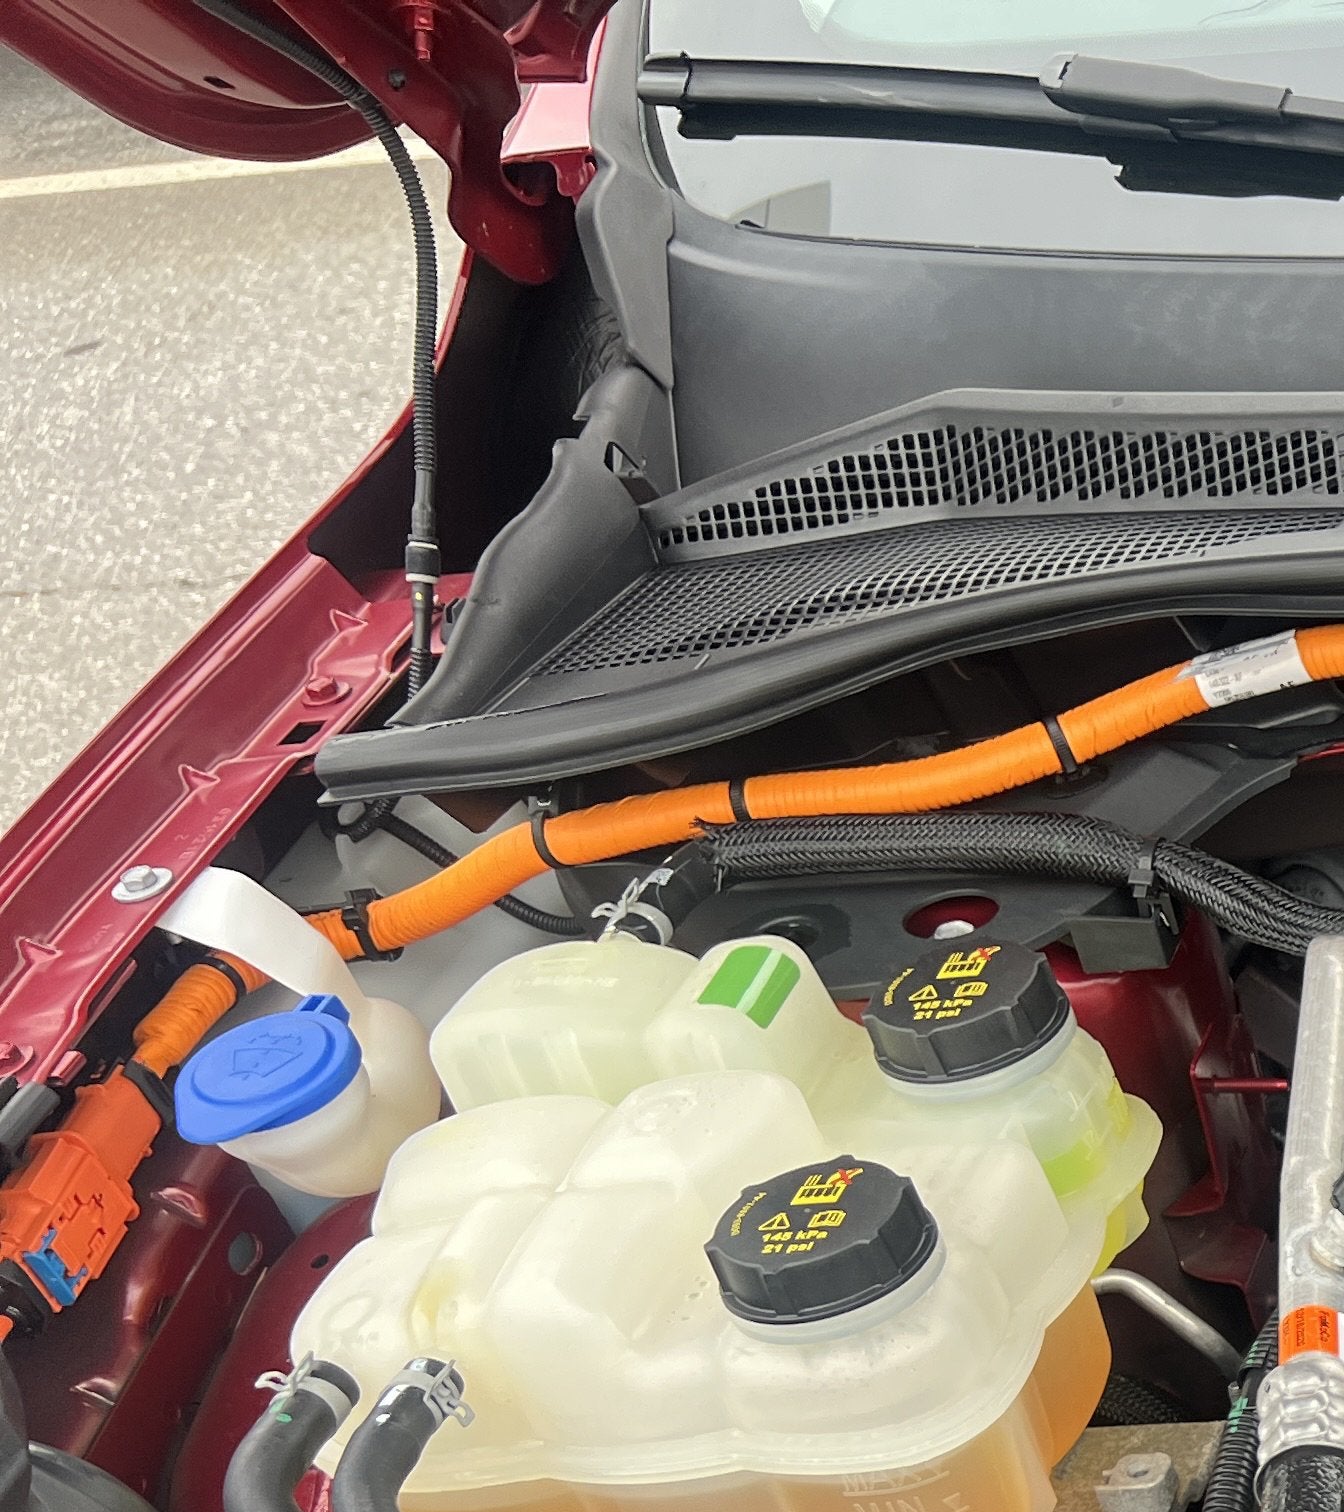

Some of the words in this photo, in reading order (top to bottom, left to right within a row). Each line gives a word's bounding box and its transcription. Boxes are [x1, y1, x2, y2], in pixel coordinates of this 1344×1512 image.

[942, 998, 974, 1009] kPa
[913, 1010, 934, 1021] 21
[935, 1008, 962, 1020] psi
[761, 1231, 793, 1243] 145
[795, 1229, 829, 1241] kPa
[761, 1243, 782, 1255] 21
[785, 1241, 815, 1255] psi
